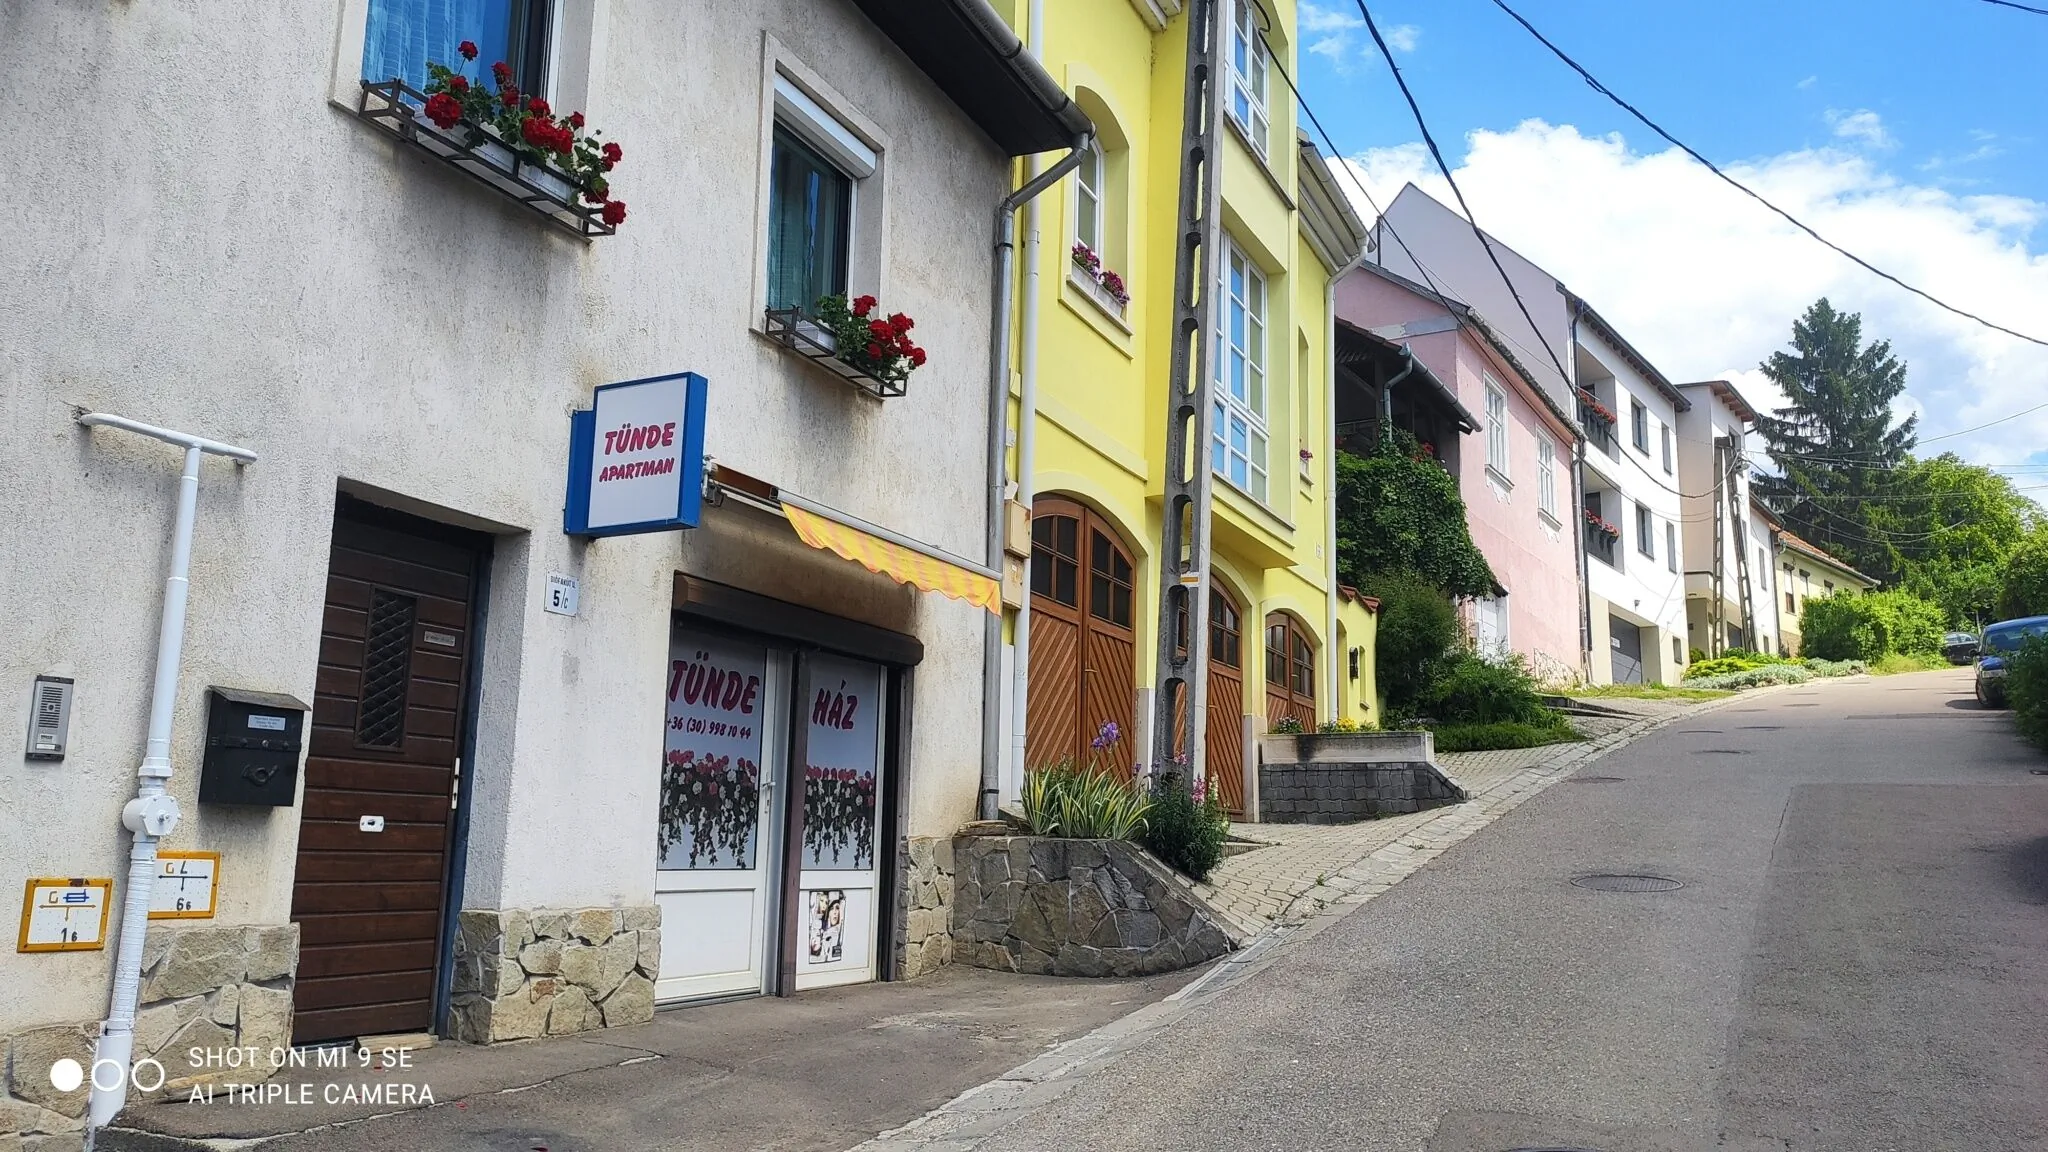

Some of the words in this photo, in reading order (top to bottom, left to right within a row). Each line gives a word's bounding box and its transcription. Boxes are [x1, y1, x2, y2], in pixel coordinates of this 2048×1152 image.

[604, 422, 676, 455] TÜNDE
[599, 457, 675, 482] APARTMAN
[669, 650, 760, 714] TÜNDE
[812, 679, 858, 730] HÁZ
[666, 716, 683, 730] +36
[686, 717, 706, 734] (30)
[709, 721, 727, 736] 998
[727, 725, 738, 738] 10
[739, 726, 752, 740] 44
